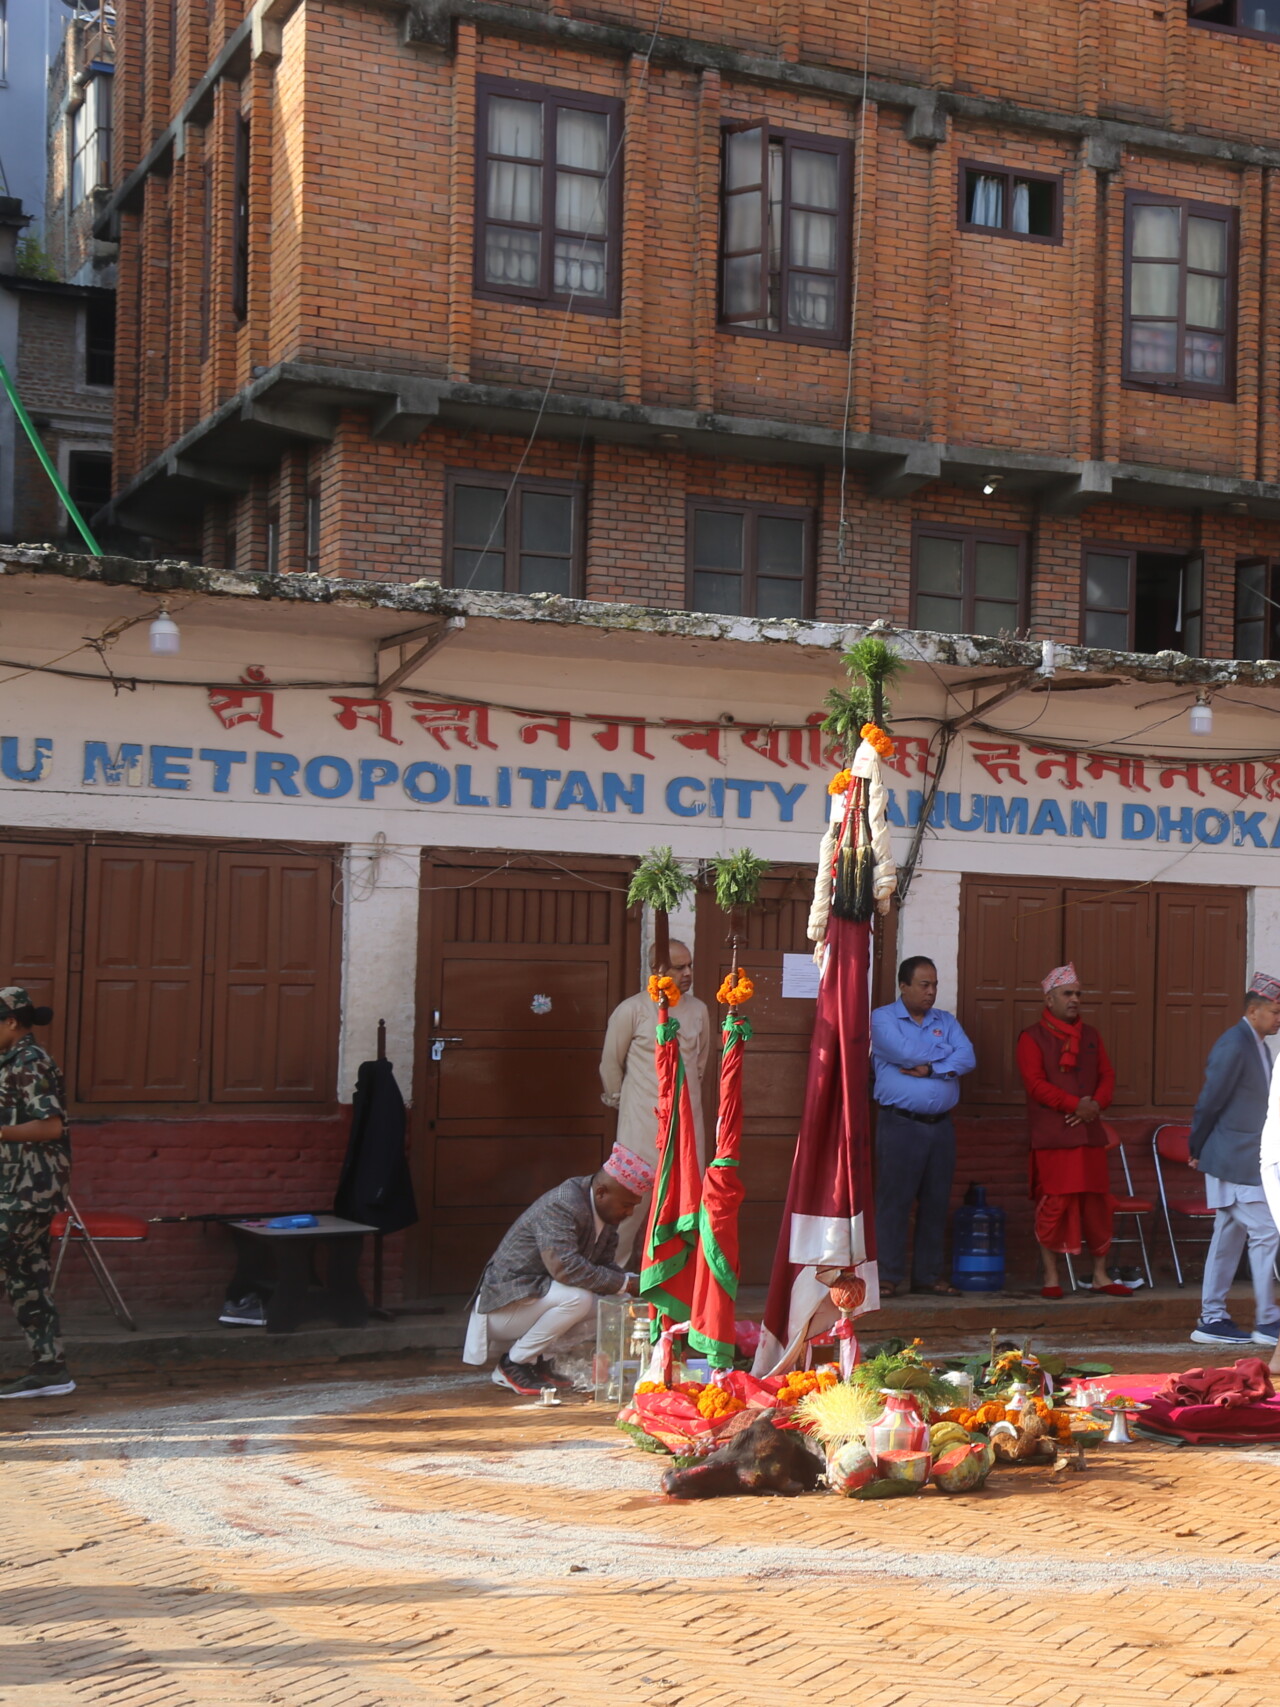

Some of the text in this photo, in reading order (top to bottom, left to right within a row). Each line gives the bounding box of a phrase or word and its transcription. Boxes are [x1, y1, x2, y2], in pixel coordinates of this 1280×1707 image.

[83, 741, 645, 814] METROPOLITAN
[666, 776, 807, 822] CITY
[825, 785, 1108, 839] ANUMAN
